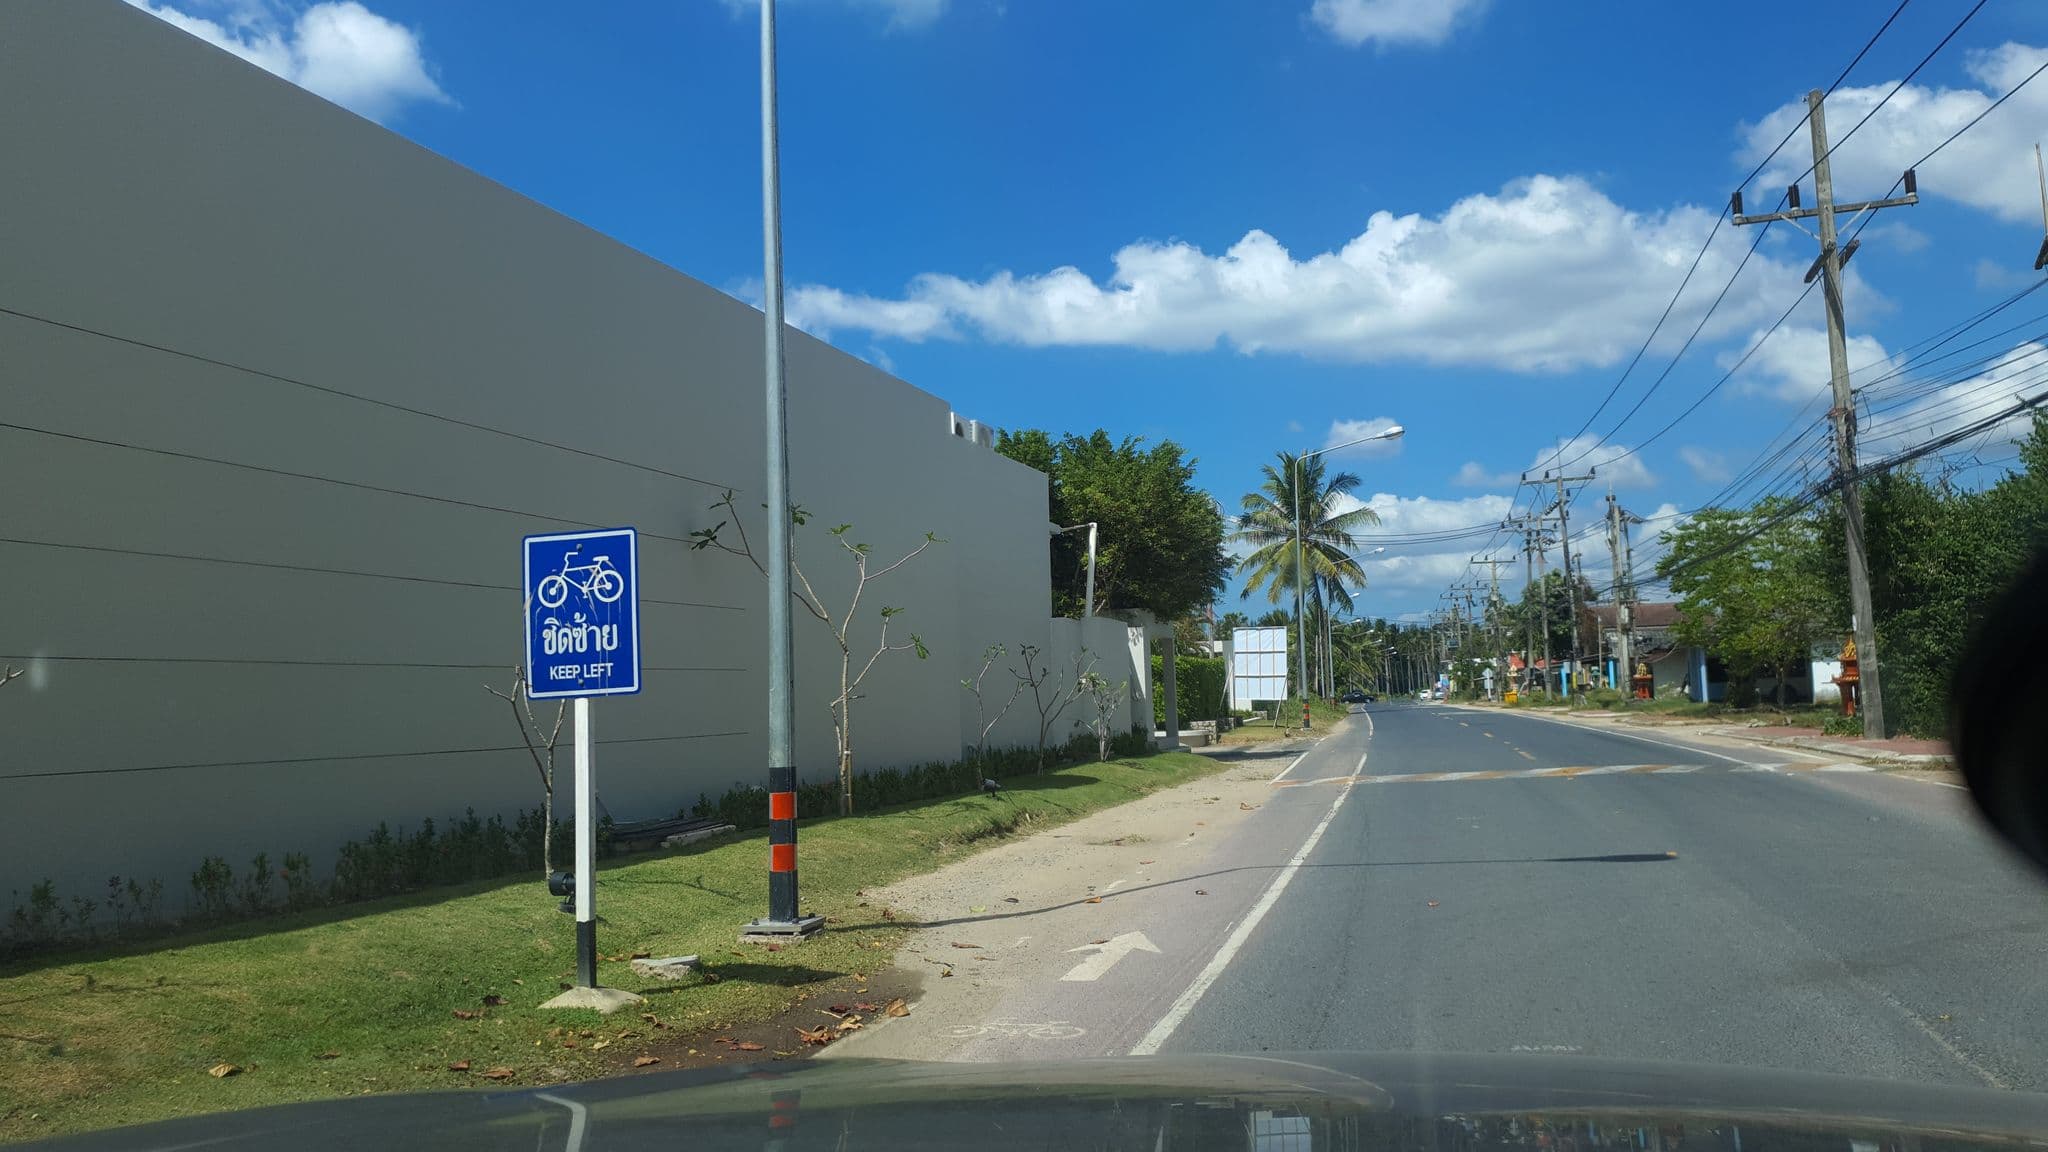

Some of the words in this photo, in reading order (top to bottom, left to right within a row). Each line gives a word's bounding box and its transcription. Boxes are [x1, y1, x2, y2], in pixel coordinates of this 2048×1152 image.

[542, 612, 618, 655] ชิดซ้าย
[549, 664, 581, 680] KEEP
[583, 662, 614, 678] LEFT
